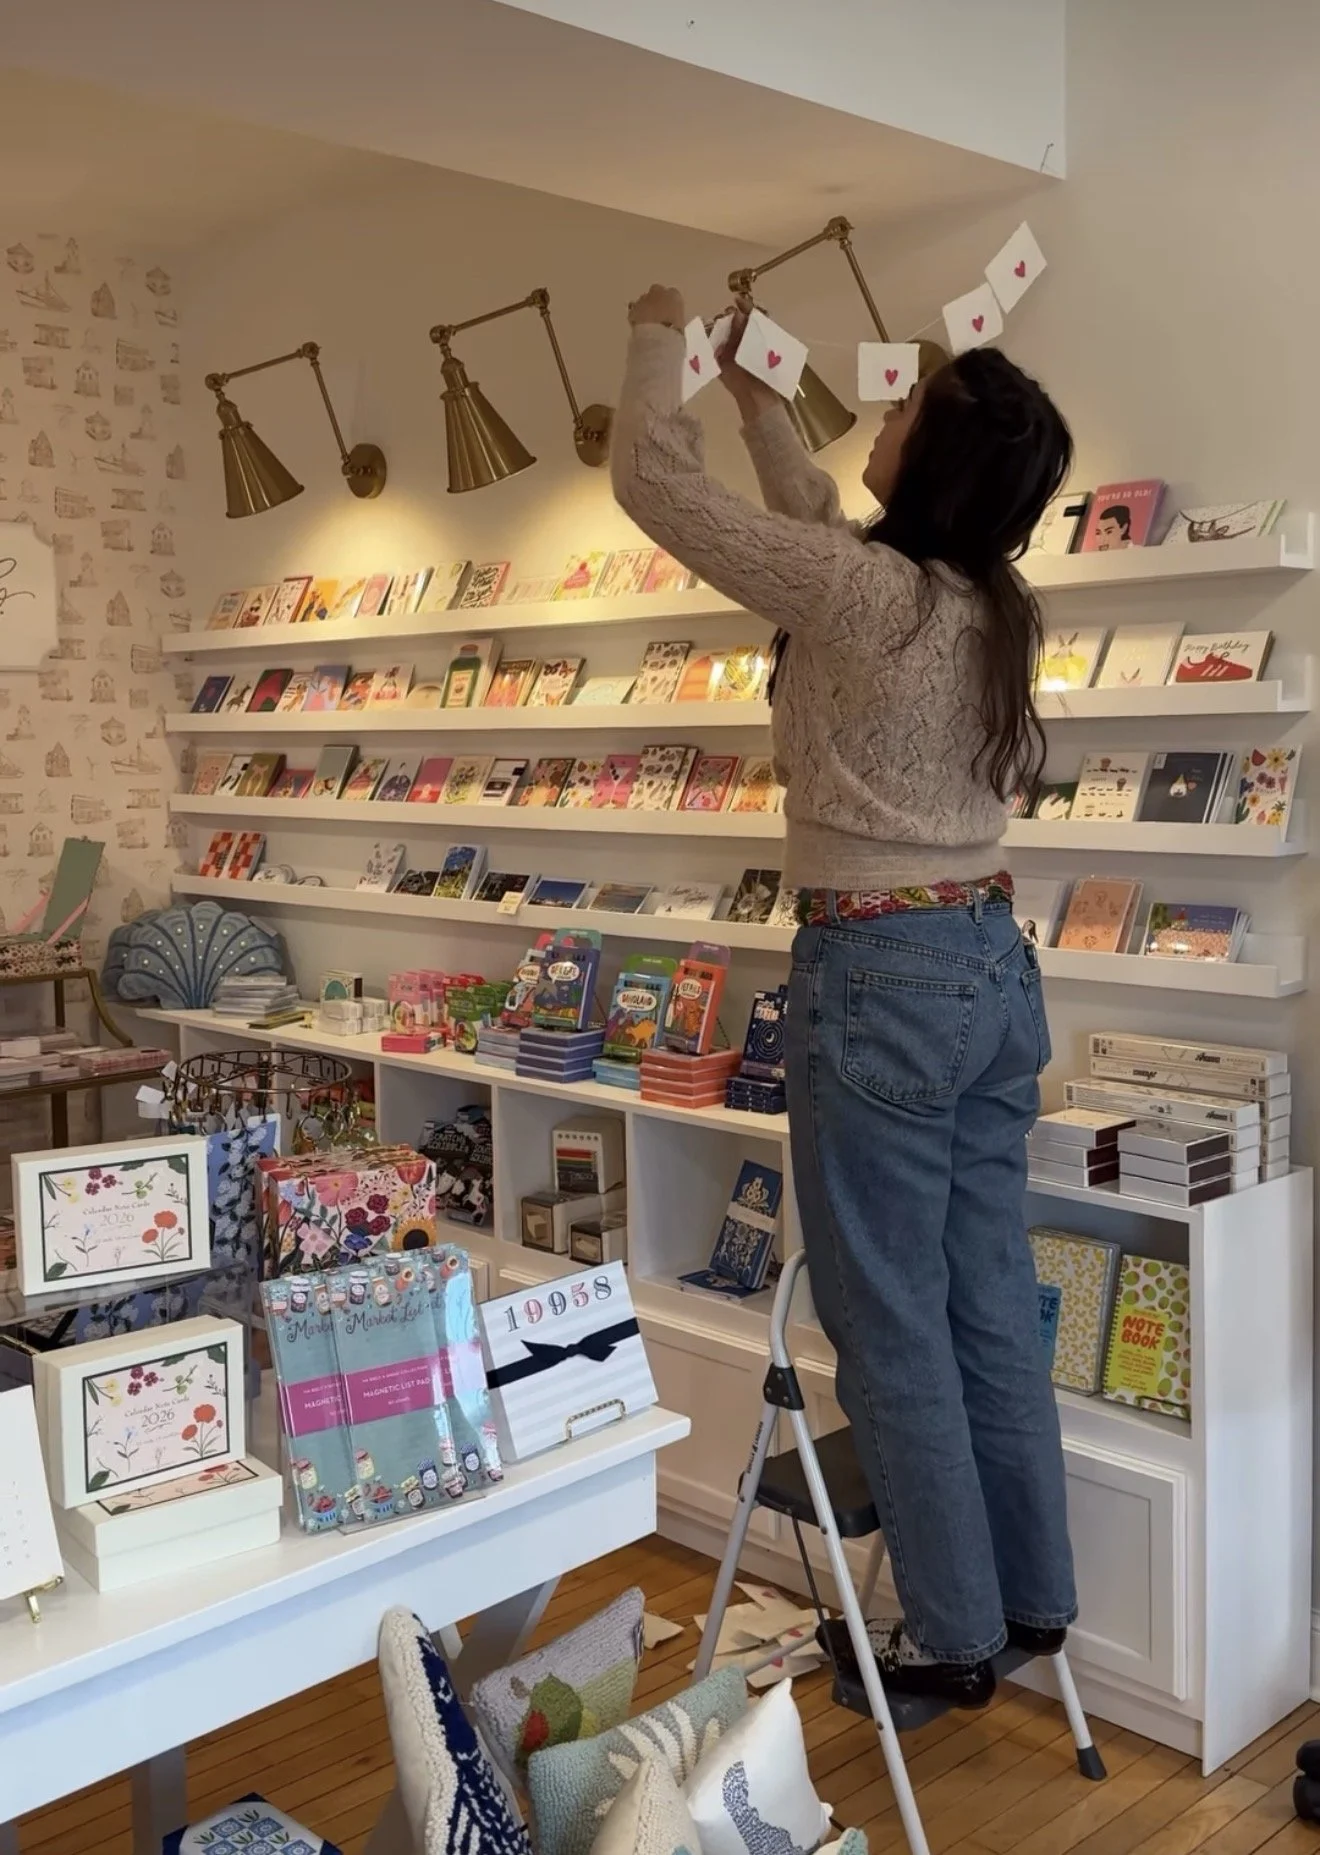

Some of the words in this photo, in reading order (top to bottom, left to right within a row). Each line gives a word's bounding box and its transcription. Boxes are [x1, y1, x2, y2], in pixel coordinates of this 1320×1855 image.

[100, 1212, 135, 1227] 2026
[503, 1275, 612, 1333] 19958
[345, 1307, 398, 1335] Market
[400, 1301, 425, 1323] List
[1122, 1315, 1165, 1337] NOTE
[1121, 1329, 1161, 1350] BOOK
[363, 1385, 400, 1399] MAGNETIC
[401, 1380, 416, 1391] LIST
[416, 1377, 431, 1387] PAD
[141, 1408, 176, 1428] 2026
